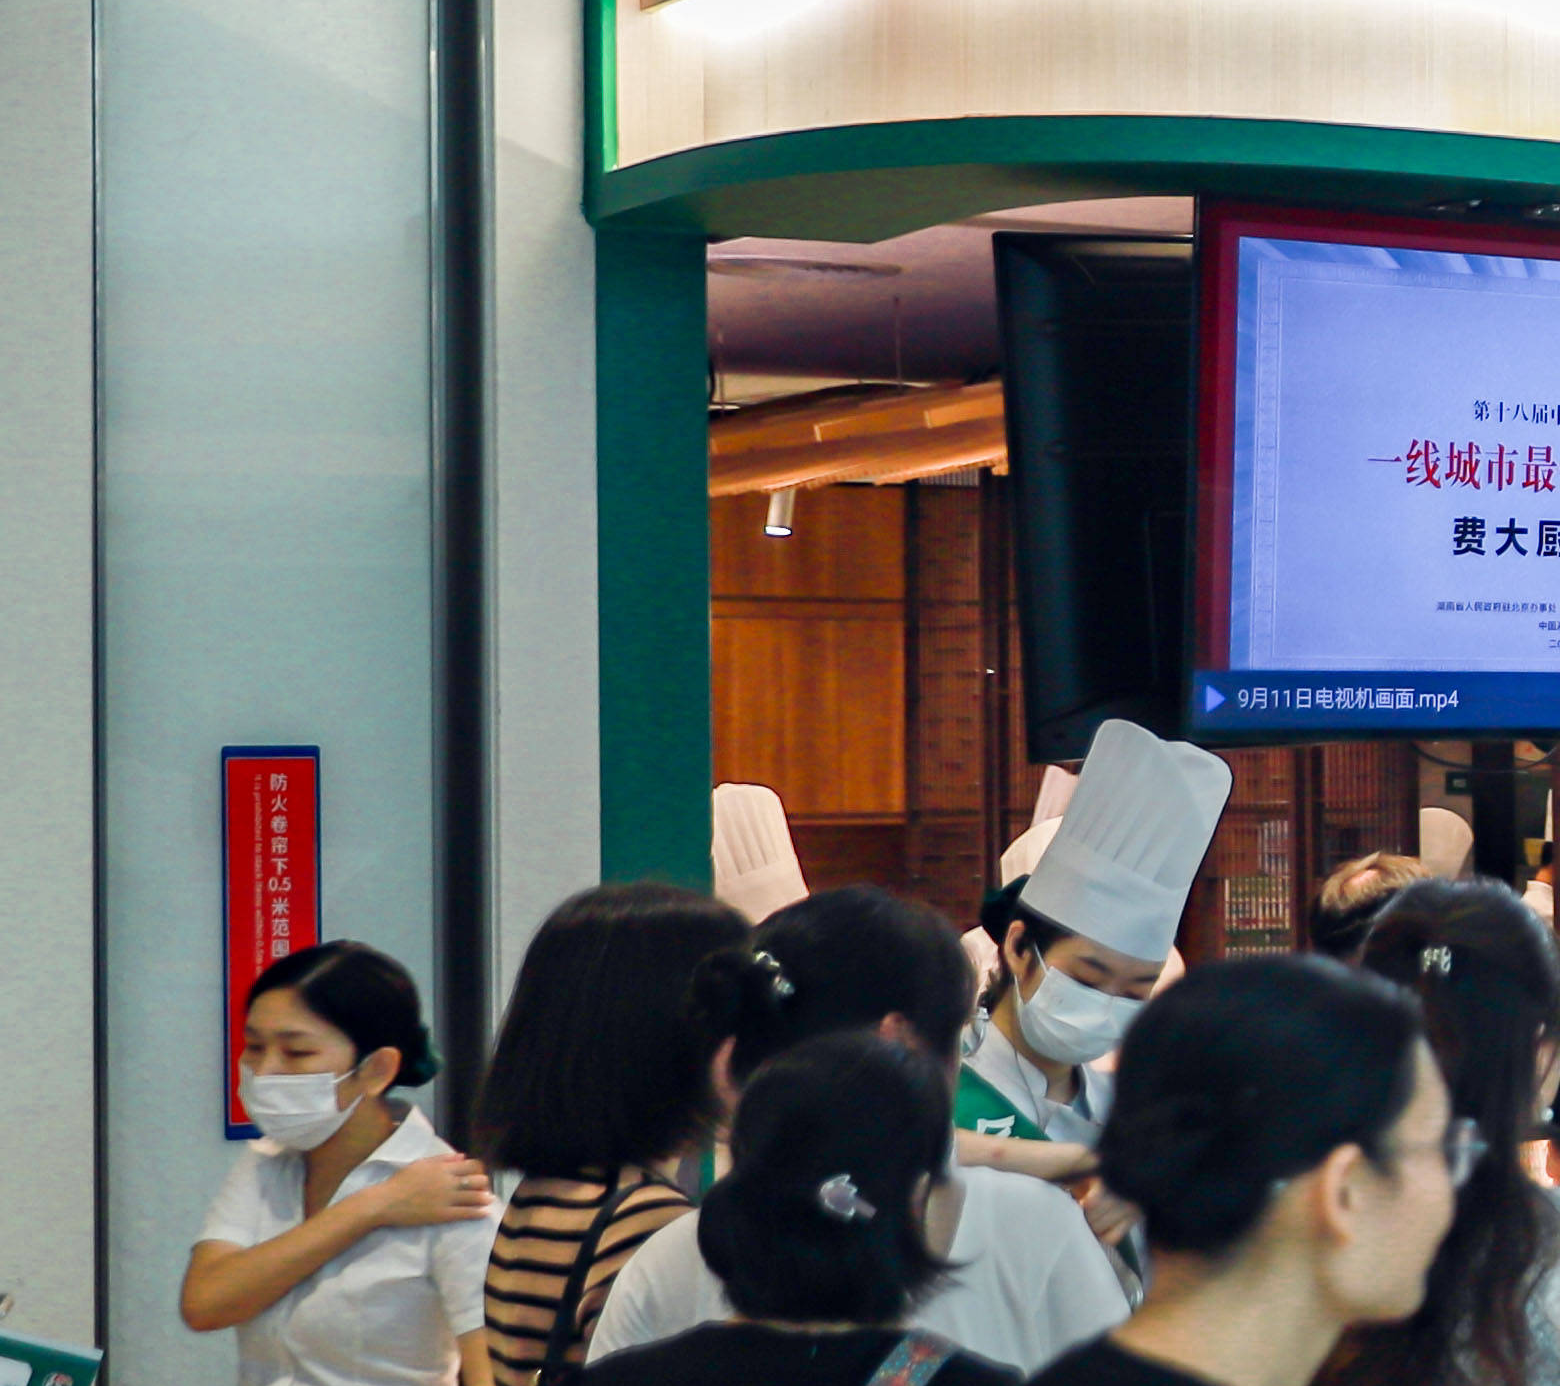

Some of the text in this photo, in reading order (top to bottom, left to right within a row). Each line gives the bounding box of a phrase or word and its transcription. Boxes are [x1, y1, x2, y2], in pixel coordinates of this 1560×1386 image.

[1237, 686, 1459, 715] 9月11日电视机画面.mp4
